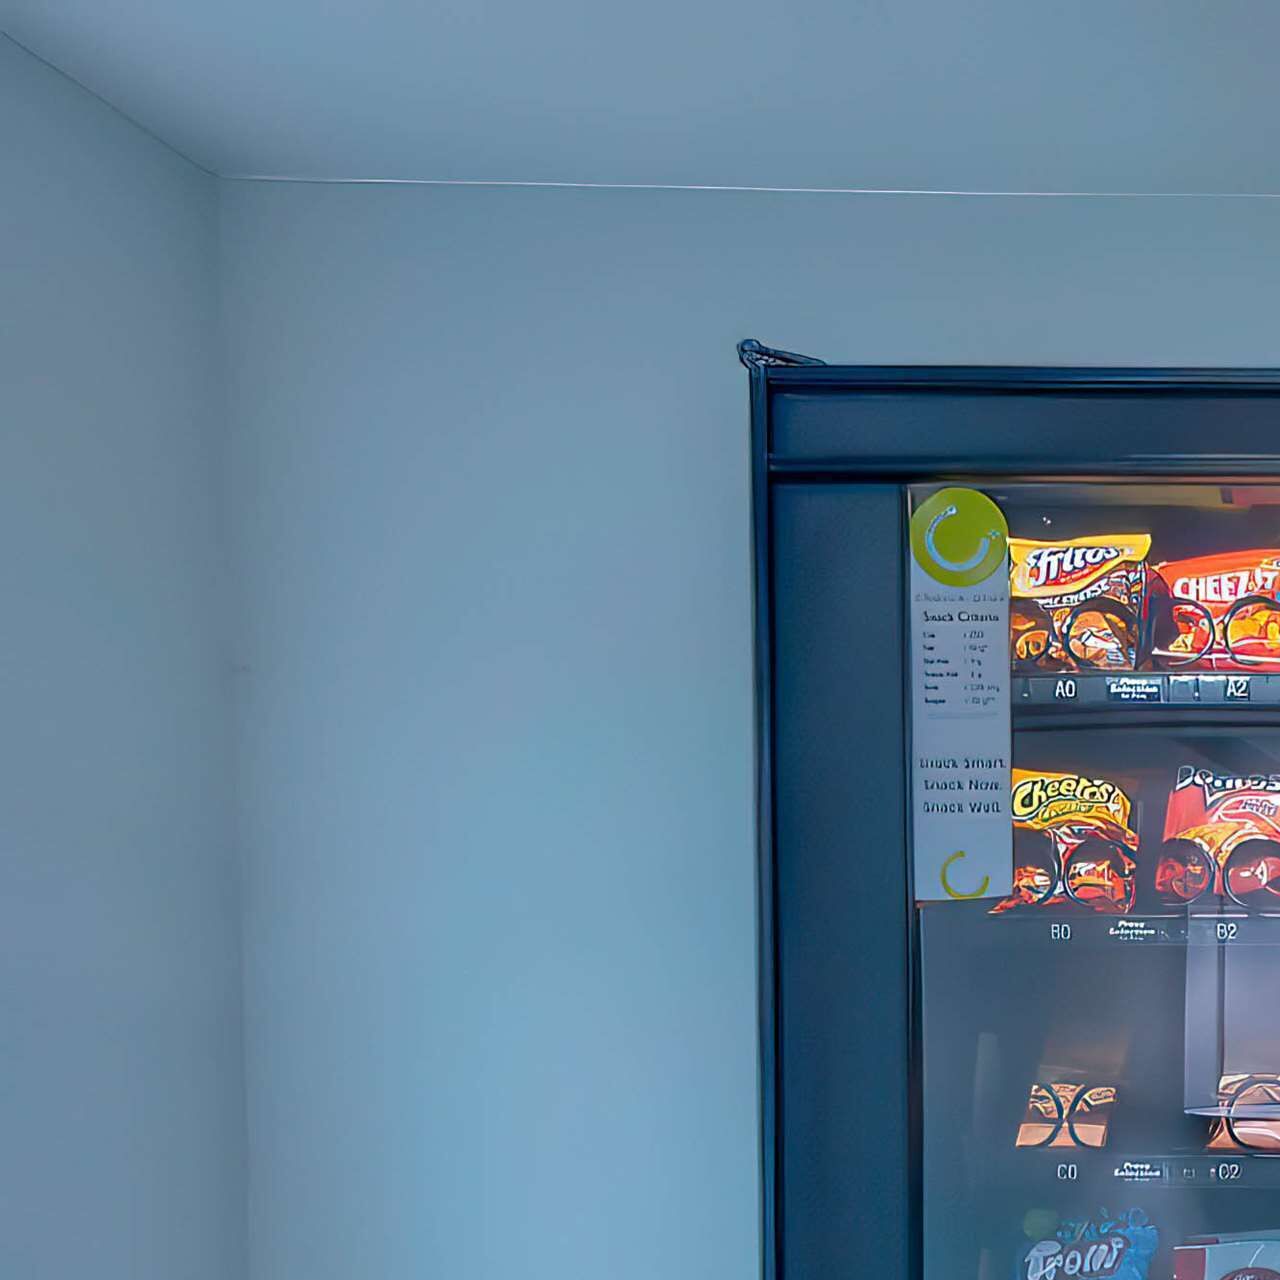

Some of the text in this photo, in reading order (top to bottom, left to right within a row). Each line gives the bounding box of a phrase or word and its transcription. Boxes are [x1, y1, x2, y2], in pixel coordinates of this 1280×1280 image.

[1026, 546, 1120, 586] Fritos
[1227, 679, 1249, 697] A2
[1013, 776, 1119, 818] Cheetos
